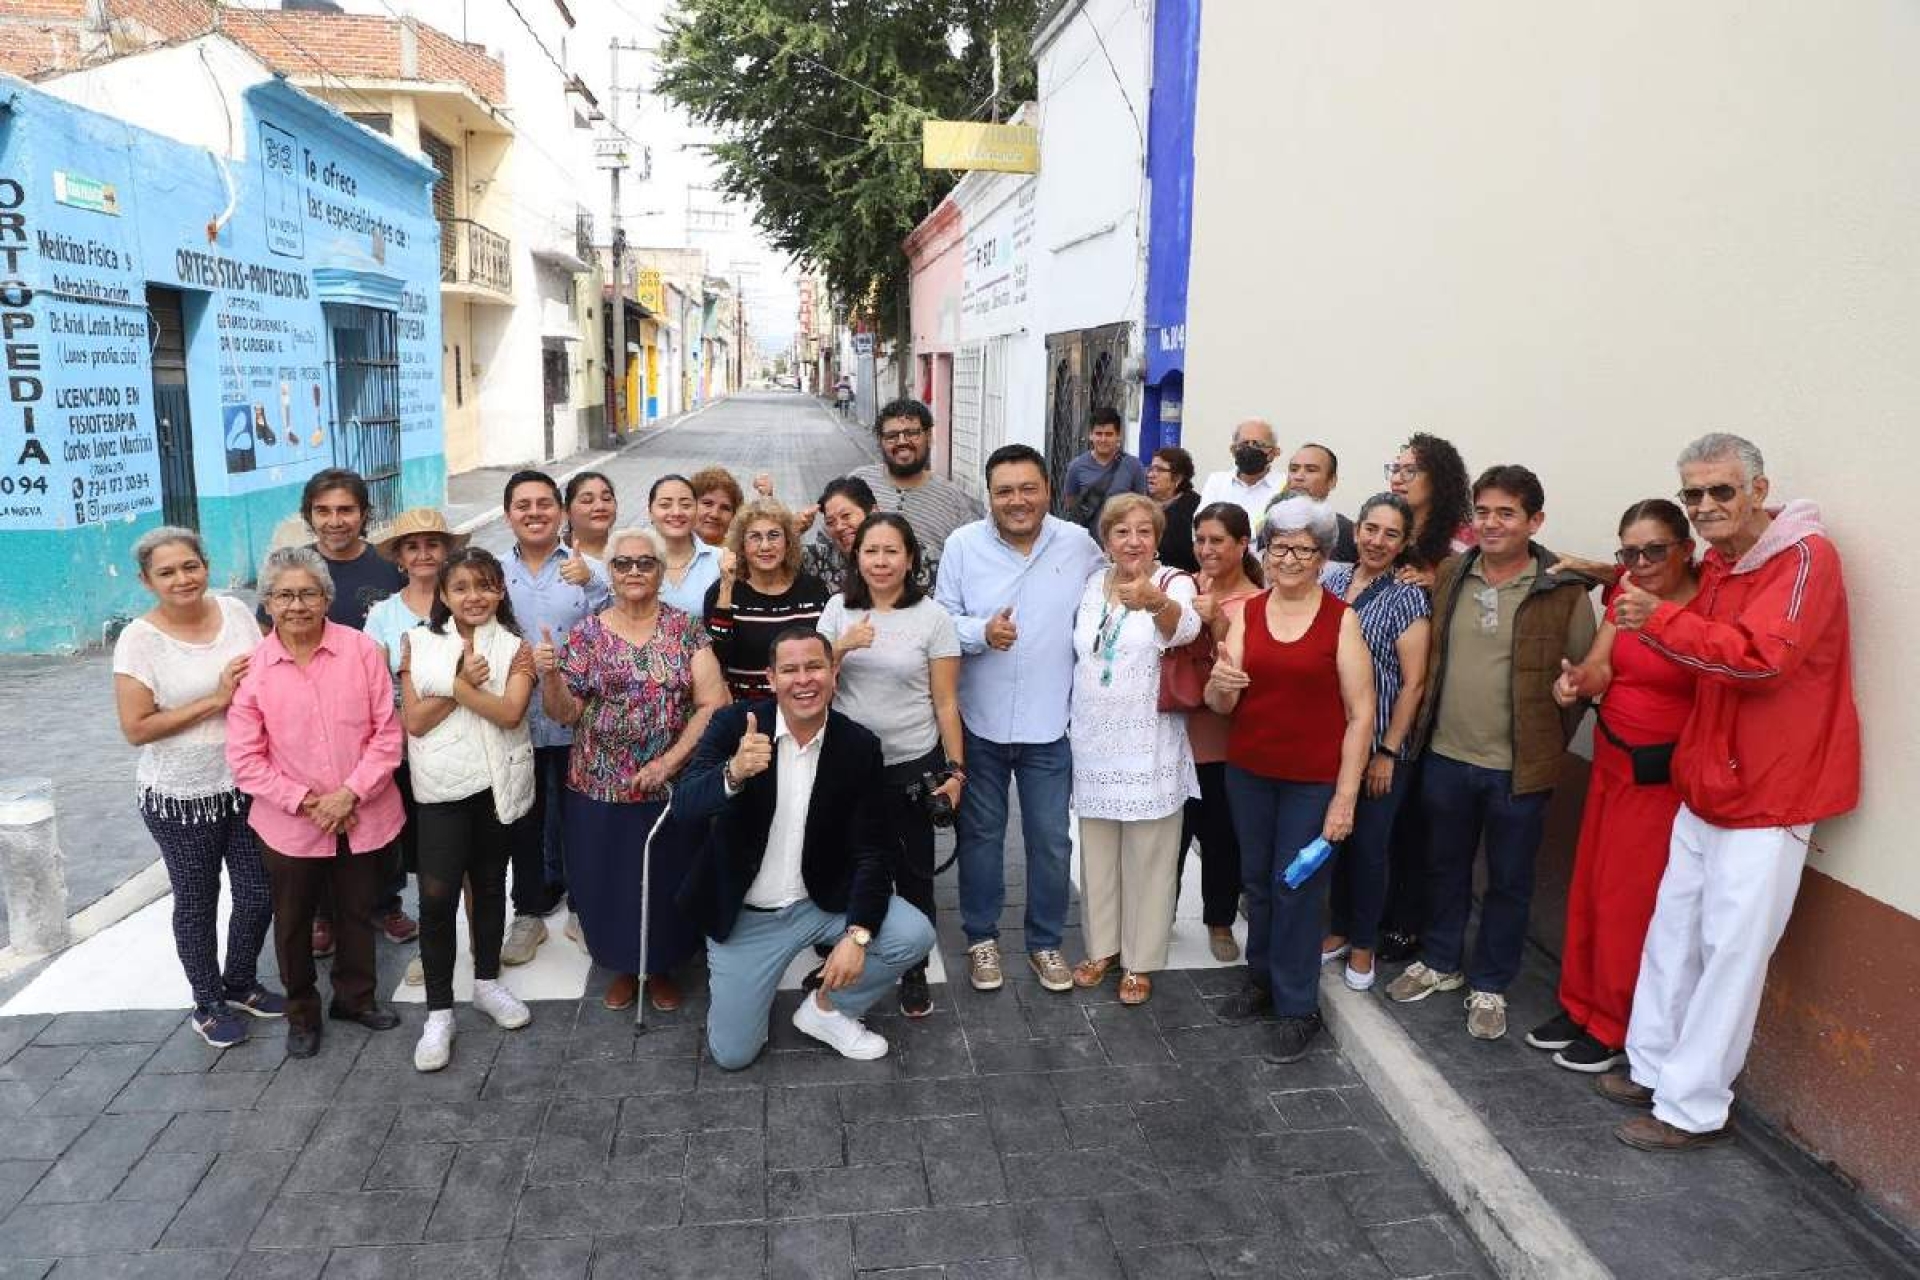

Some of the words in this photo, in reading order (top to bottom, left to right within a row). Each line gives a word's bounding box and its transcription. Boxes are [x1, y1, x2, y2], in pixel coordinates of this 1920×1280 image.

[304, 148, 316, 182] Te
[322, 161, 357, 198] ofrece
[56, 387, 121, 409] LICENCIADO
[126, 387, 140, 406] EN
[68, 411, 137, 436] FISIOTERAPIA
[64, 438, 91, 462] Carlos
